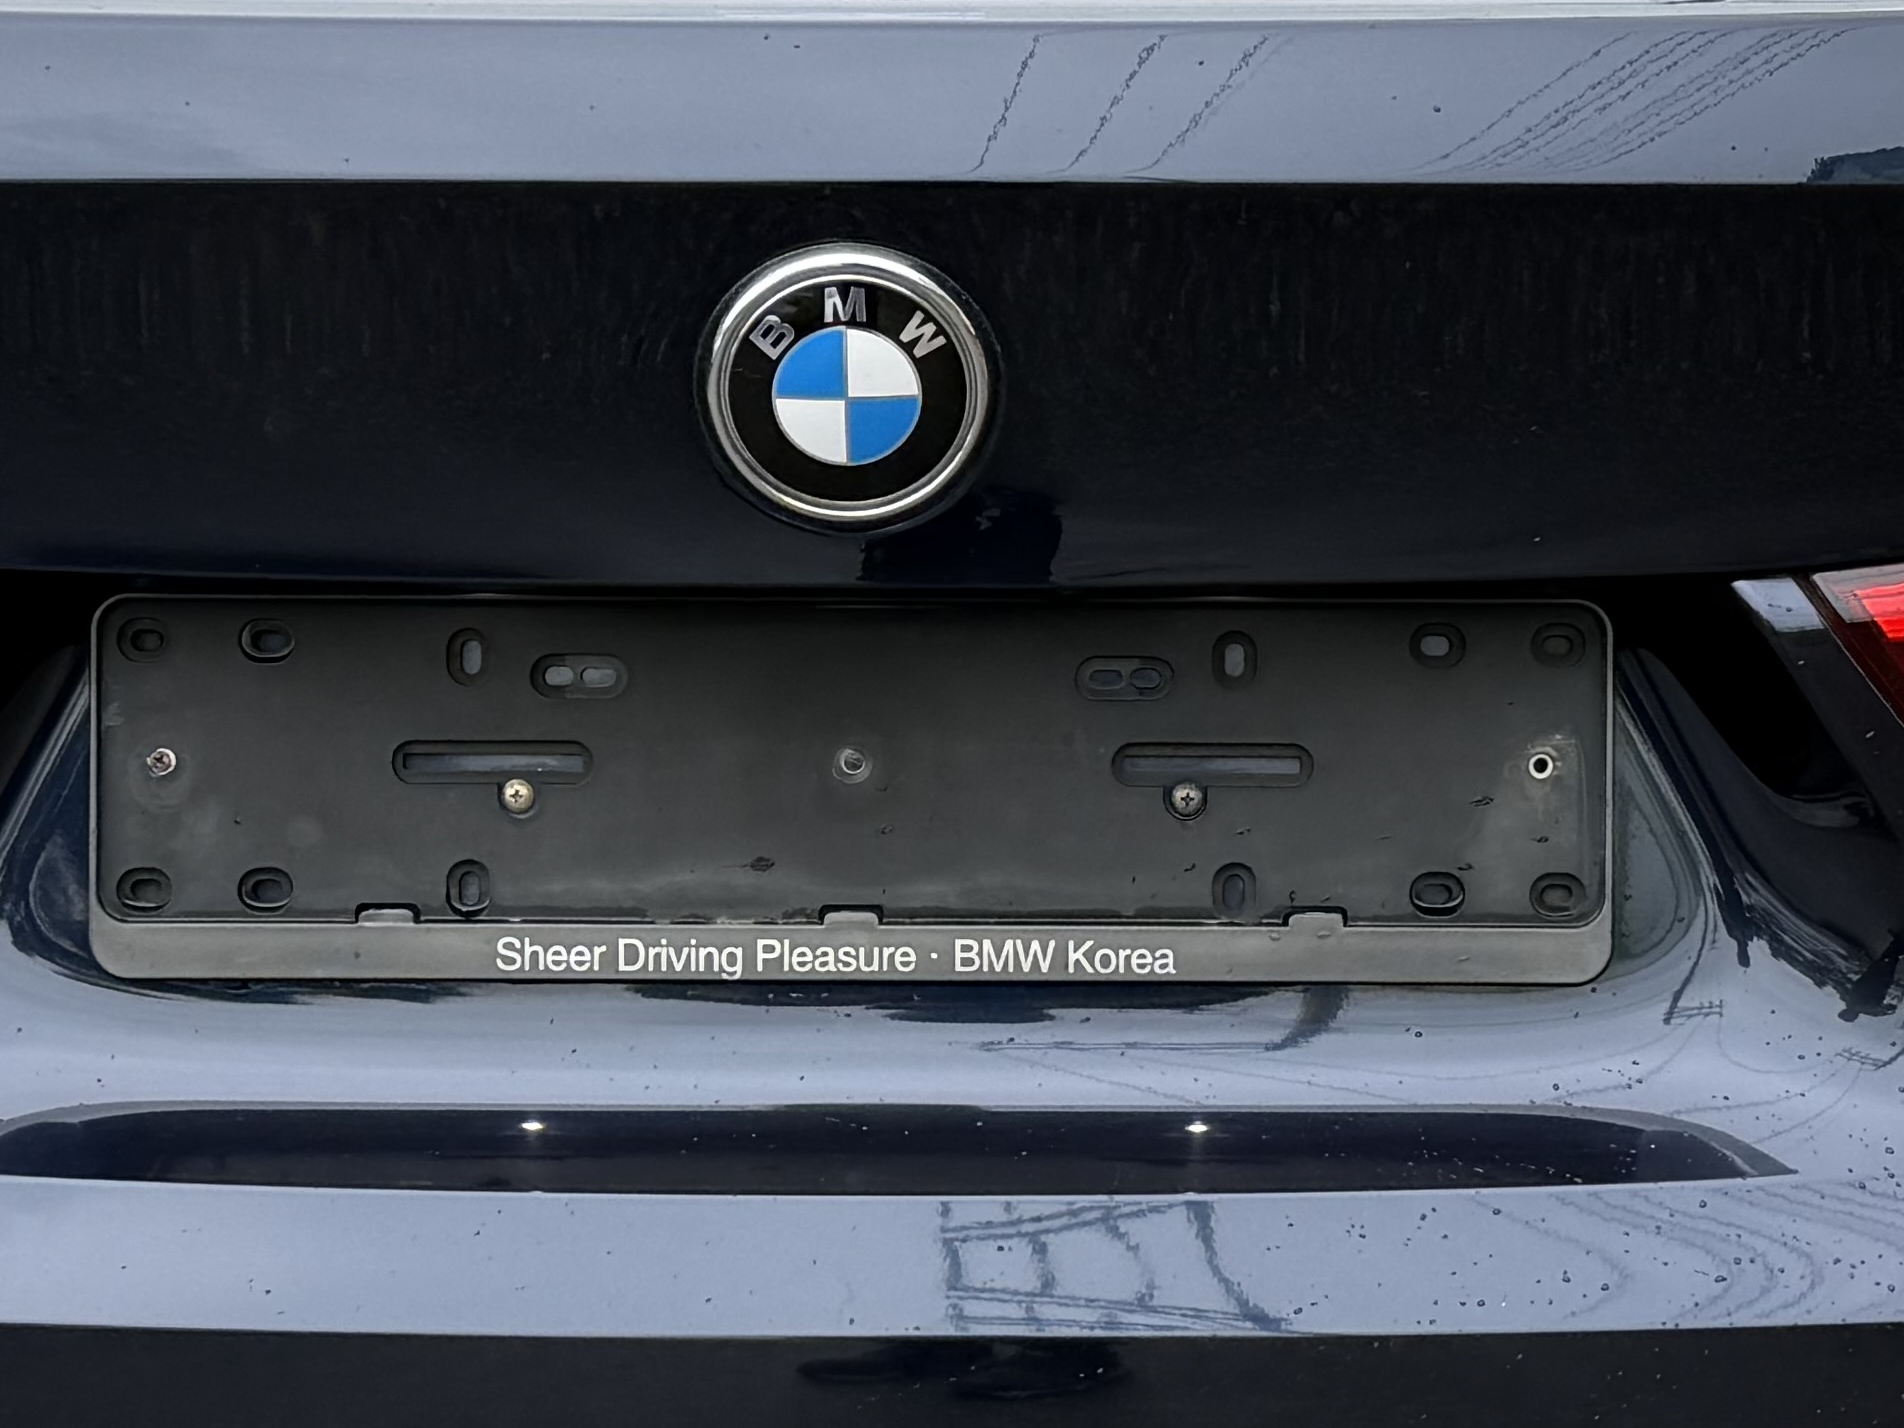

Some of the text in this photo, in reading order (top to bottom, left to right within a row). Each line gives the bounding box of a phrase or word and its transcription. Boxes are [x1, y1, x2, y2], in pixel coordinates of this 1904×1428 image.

[748, 286, 948, 361] BMW
[495, 936, 607, 972] Sheer
[618, 937, 743, 980] Driving
[756, 938, 917, 972] Pleasure
[954, 938, 1056, 973] BMW
[1068, 939, 1177, 975] Korea
